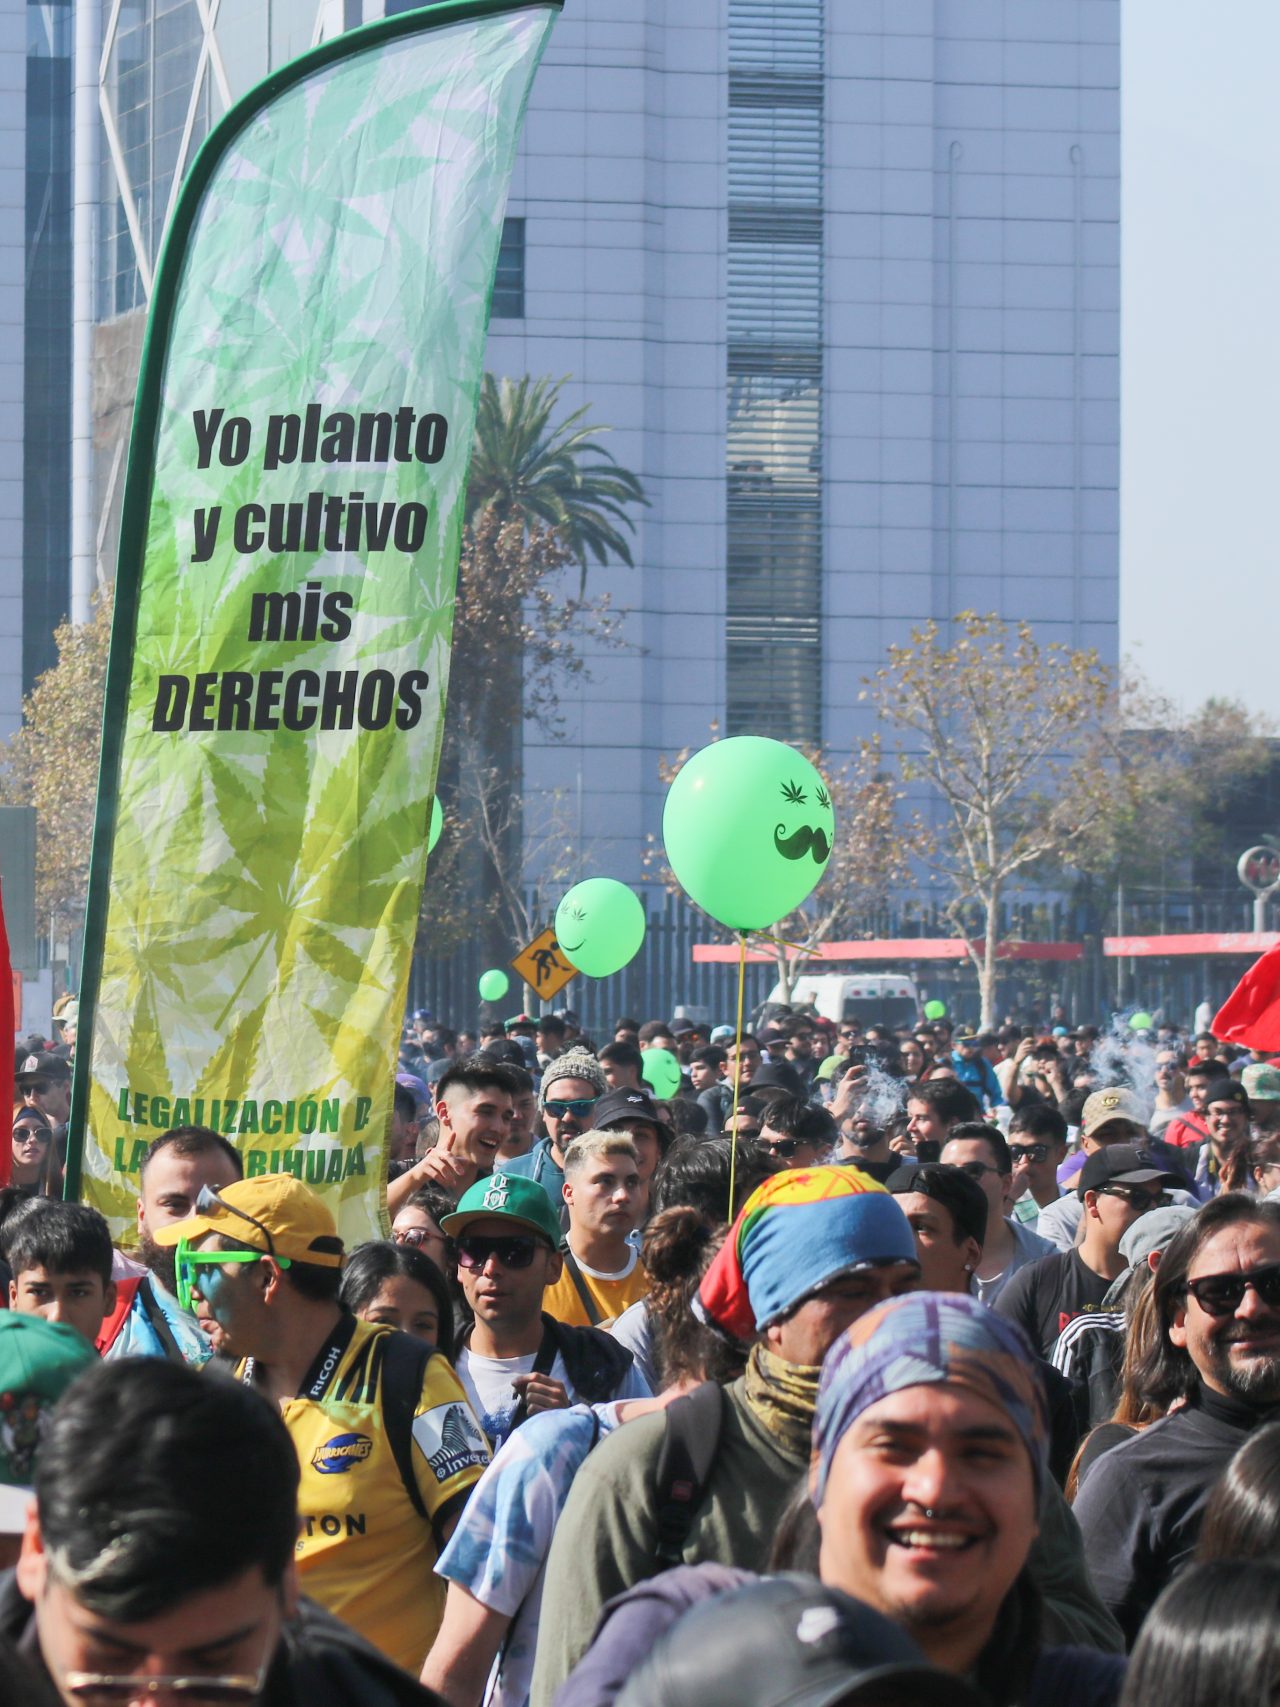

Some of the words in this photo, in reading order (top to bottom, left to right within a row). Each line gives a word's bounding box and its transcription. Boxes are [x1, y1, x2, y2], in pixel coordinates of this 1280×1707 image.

[192, 407, 252, 470] Yo
[263, 403, 449, 471] planto
[190, 505, 222, 563] y
[233, 491, 429, 554] cultivo
[247, 581, 354, 642] mis
[151, 669, 430, 732] DERECHOS
[117, 1088, 339, 1135] LEGALIZACIÓN
[244, 1140, 367, 1185] RIHUAA
[310, 1346, 342, 1397] RICOH
[305, 1513, 366, 1537] TON
